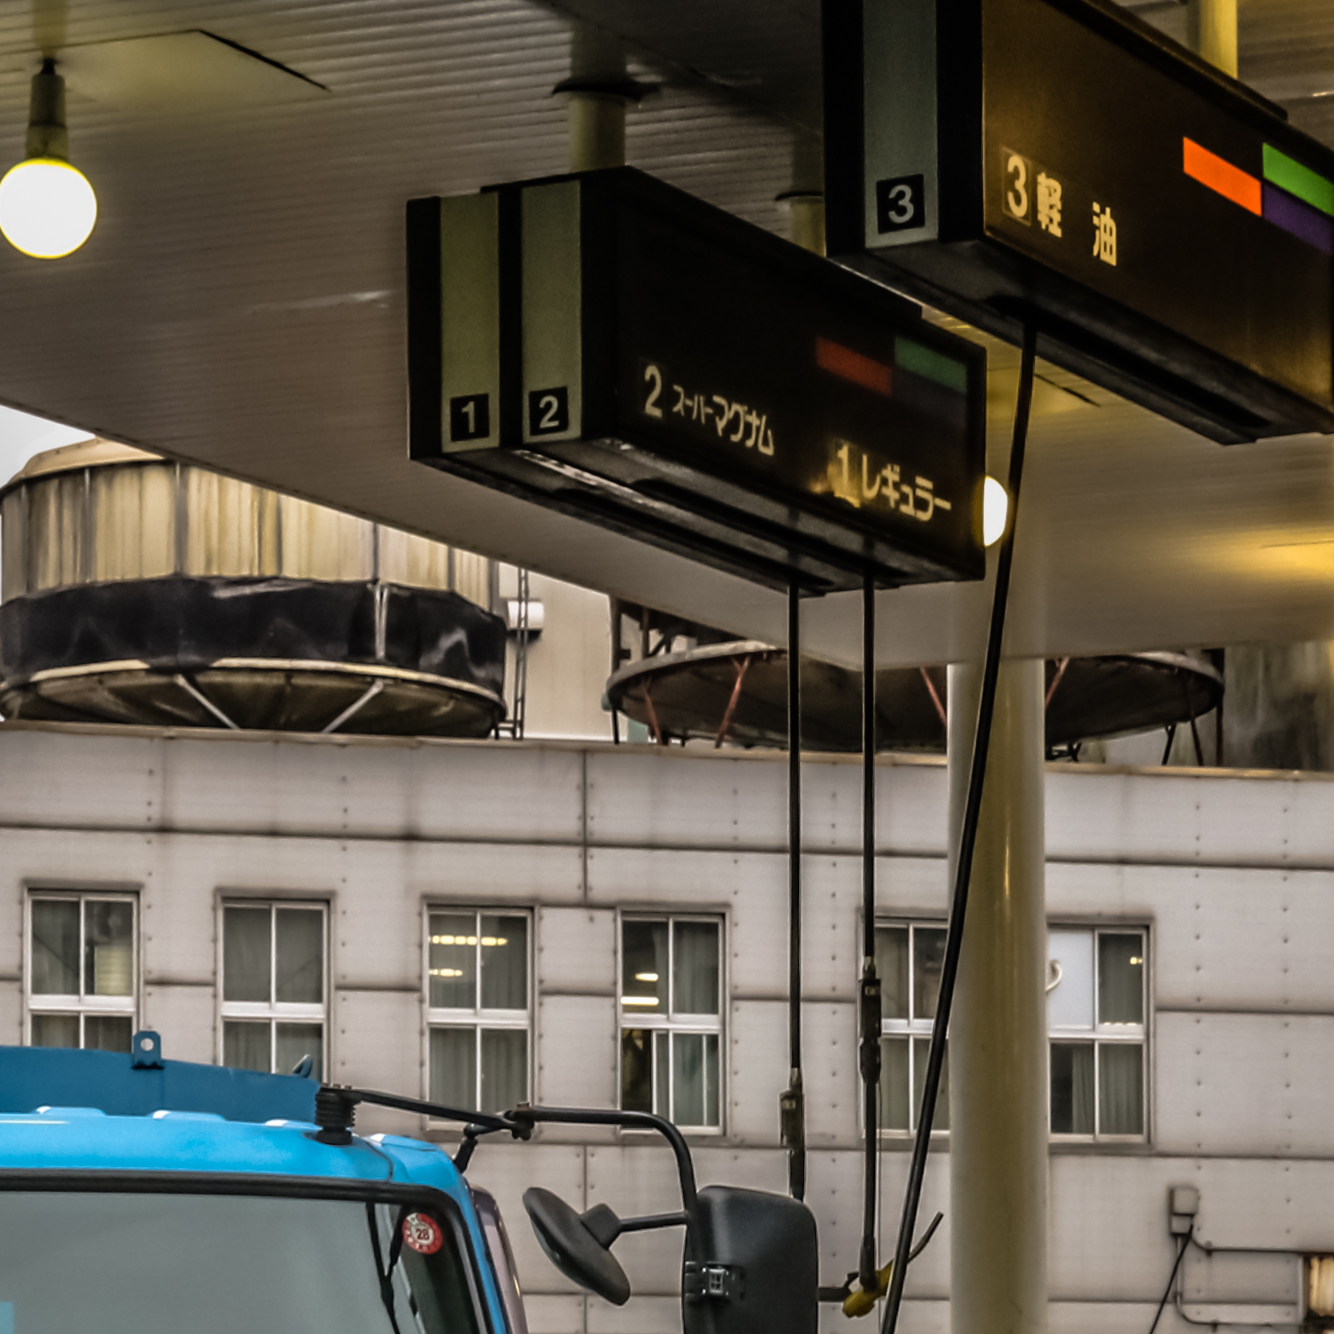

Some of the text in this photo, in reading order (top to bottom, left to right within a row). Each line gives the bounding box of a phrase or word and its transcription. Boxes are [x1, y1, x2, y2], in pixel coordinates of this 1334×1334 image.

[887, 184, 915, 224] 3
[1007, 155, 1117, 266] 3 軽油
[538, 394, 560, 430] 2
[643, 364, 663, 419] 2
[461, 400, 476, 434] 1
[863, 461, 952, 522] レギュラー
